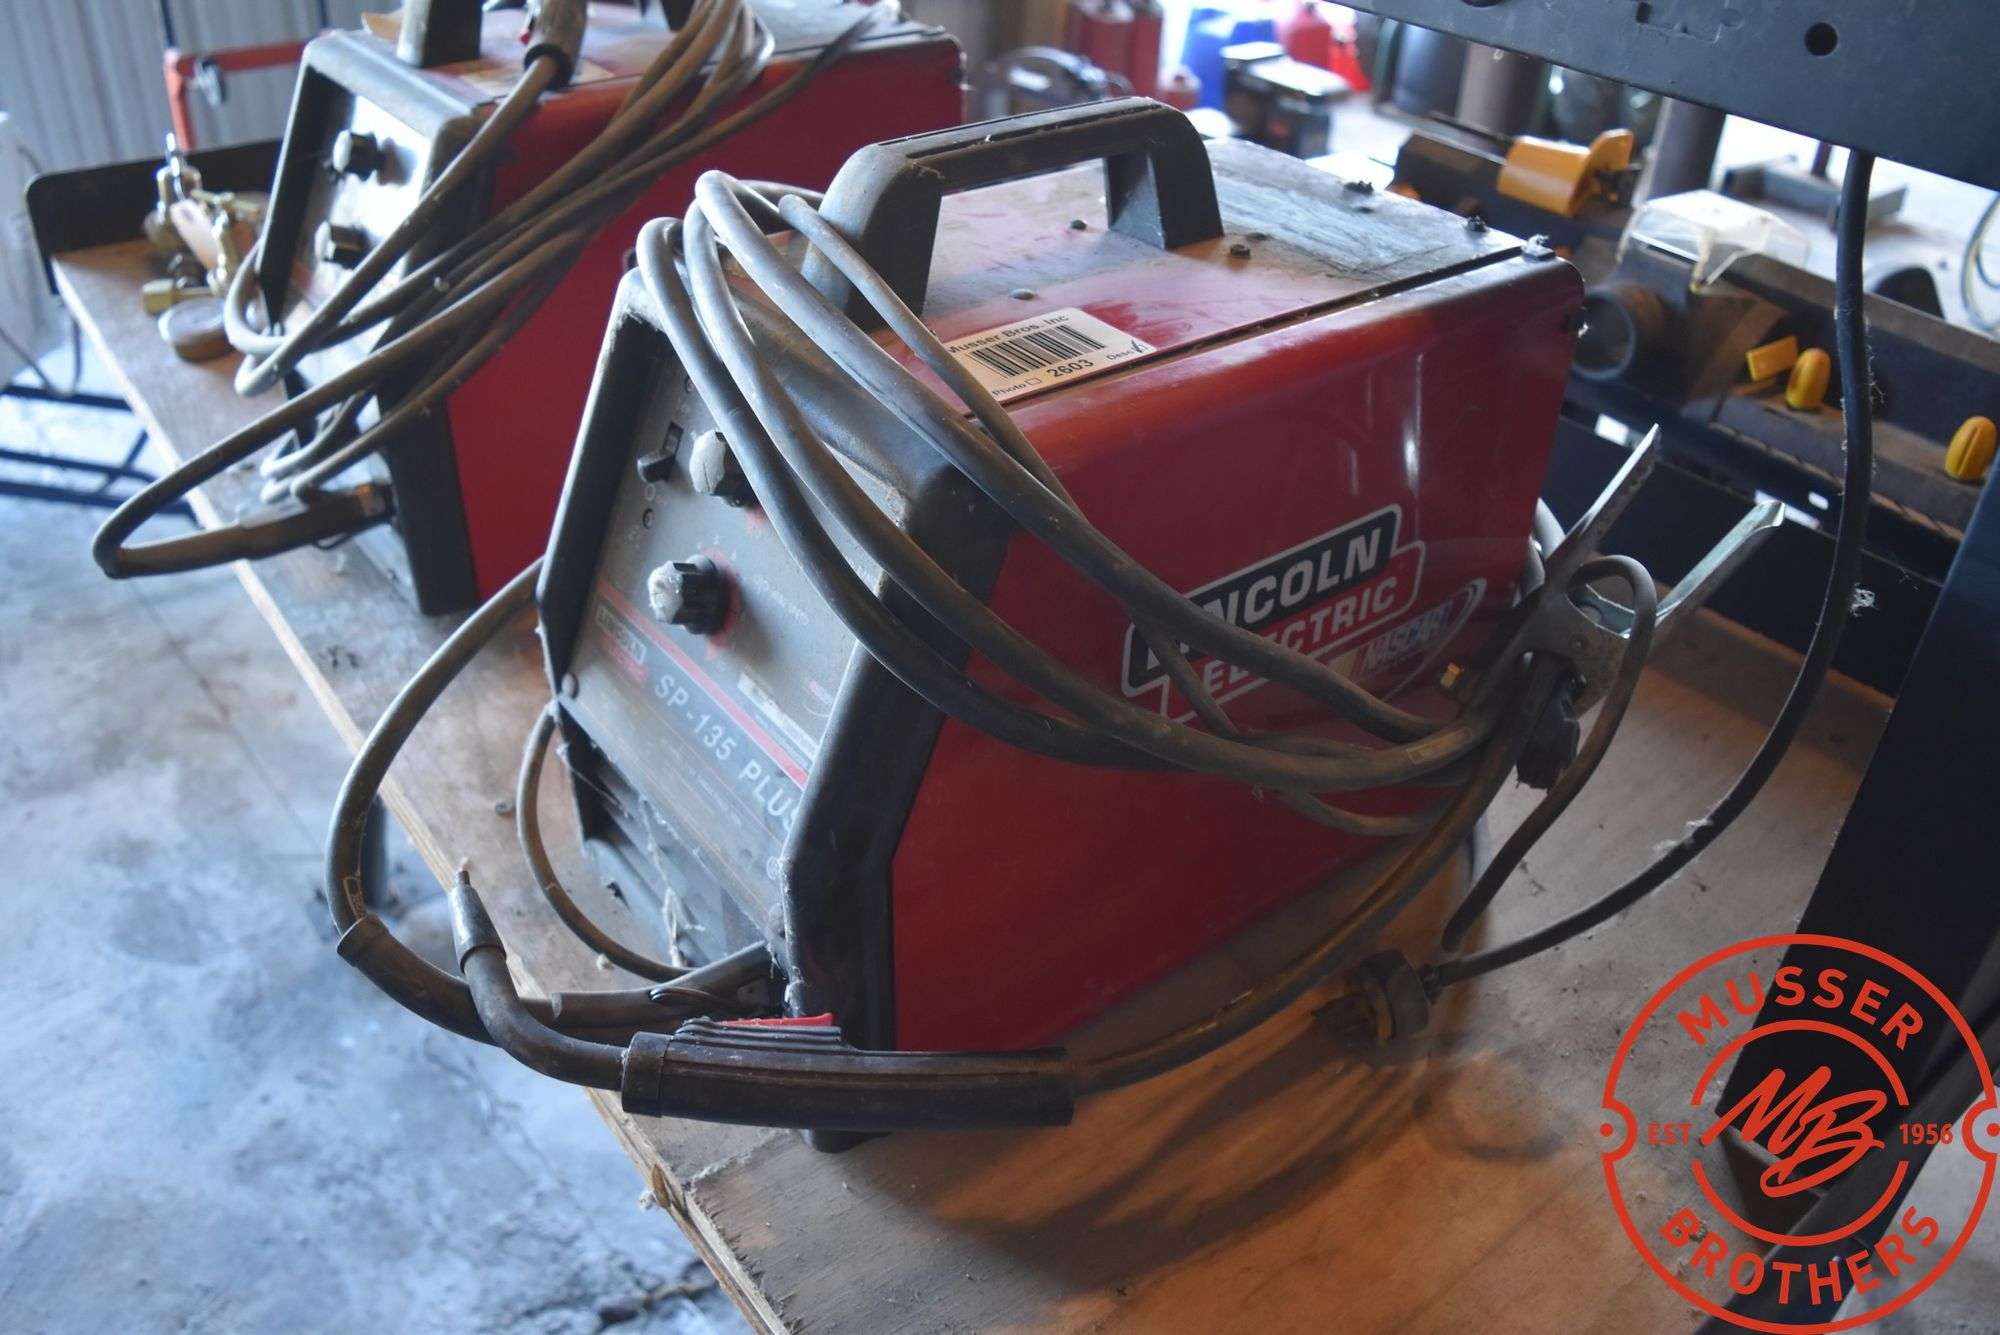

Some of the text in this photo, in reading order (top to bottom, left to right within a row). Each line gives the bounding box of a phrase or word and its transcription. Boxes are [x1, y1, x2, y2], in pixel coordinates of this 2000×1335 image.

[992, 382, 1027, 398] Photo
[1046, 358, 1095, 379] 2603
[1147, 527, 1382, 671] NCOLN
[654, 674, 737, 760] SP-135
